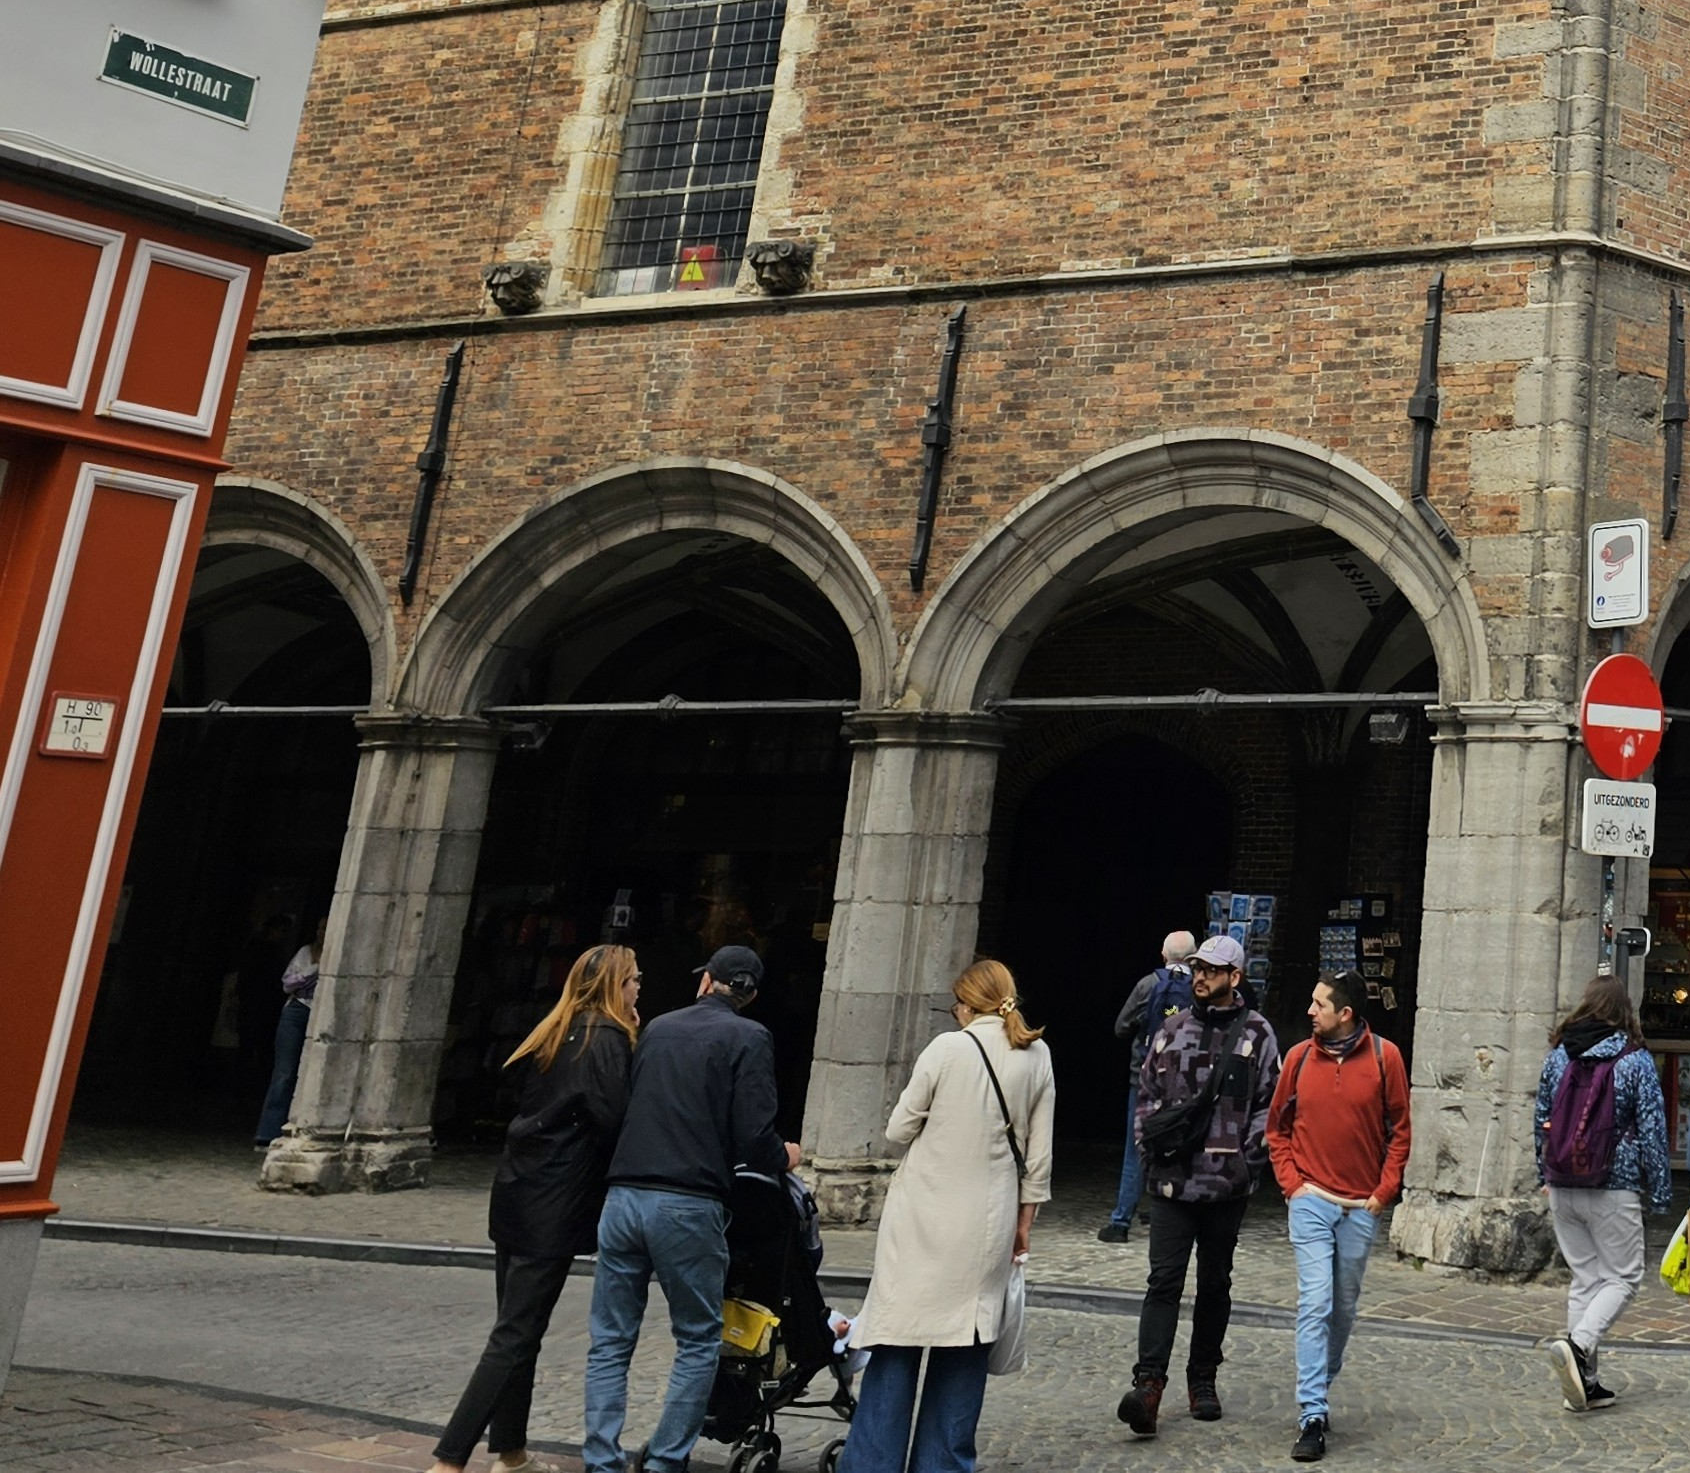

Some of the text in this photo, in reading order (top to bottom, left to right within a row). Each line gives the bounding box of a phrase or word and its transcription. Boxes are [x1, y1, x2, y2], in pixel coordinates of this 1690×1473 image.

[129, 50, 232, 102] WOLLESTRAAT
[66, 700, 103, 717] H 90
[1593, 793, 1650, 809] UITGEZONDERD
